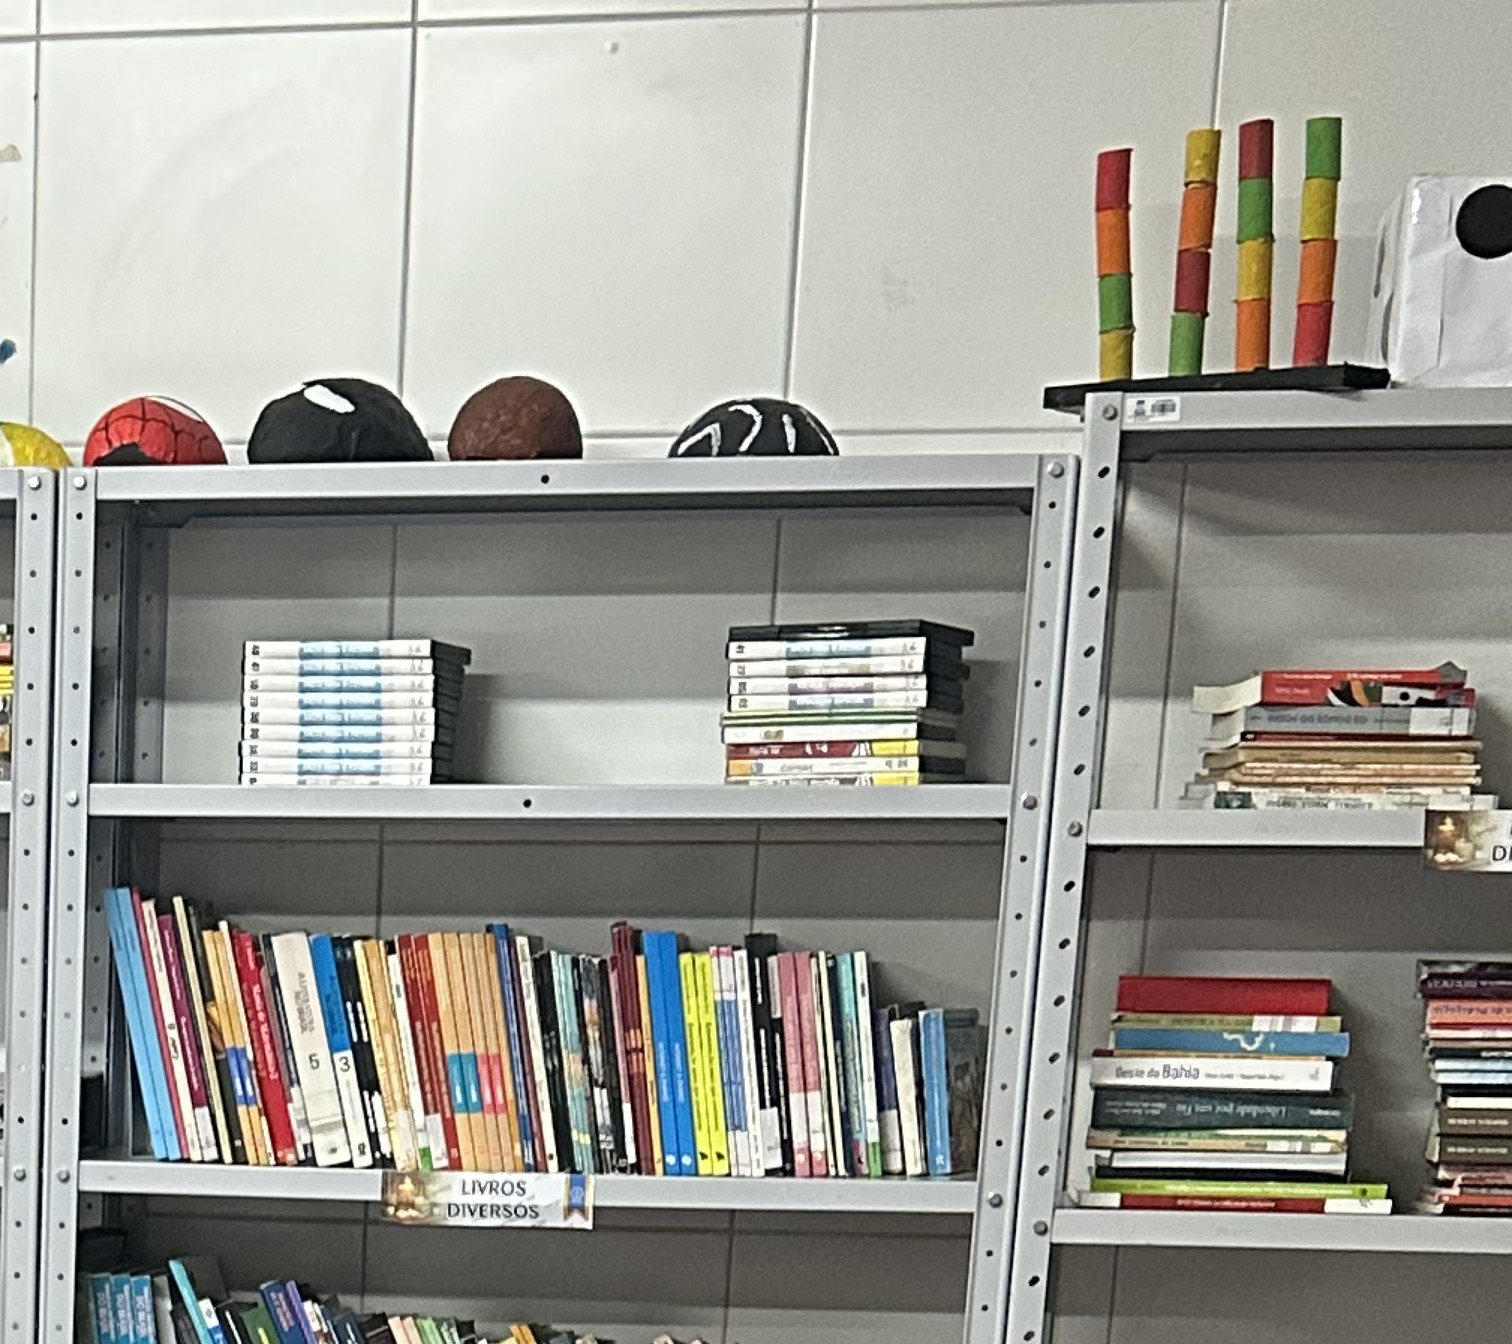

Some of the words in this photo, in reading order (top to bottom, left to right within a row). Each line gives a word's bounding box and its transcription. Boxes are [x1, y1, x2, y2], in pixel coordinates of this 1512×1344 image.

[309, 1053, 320, 1070] 5
[339, 1057, 351, 1072] 3
[461, 1179, 526, 1197] LIVROS
[448, 1202, 540, 1219] DIVERSOS
